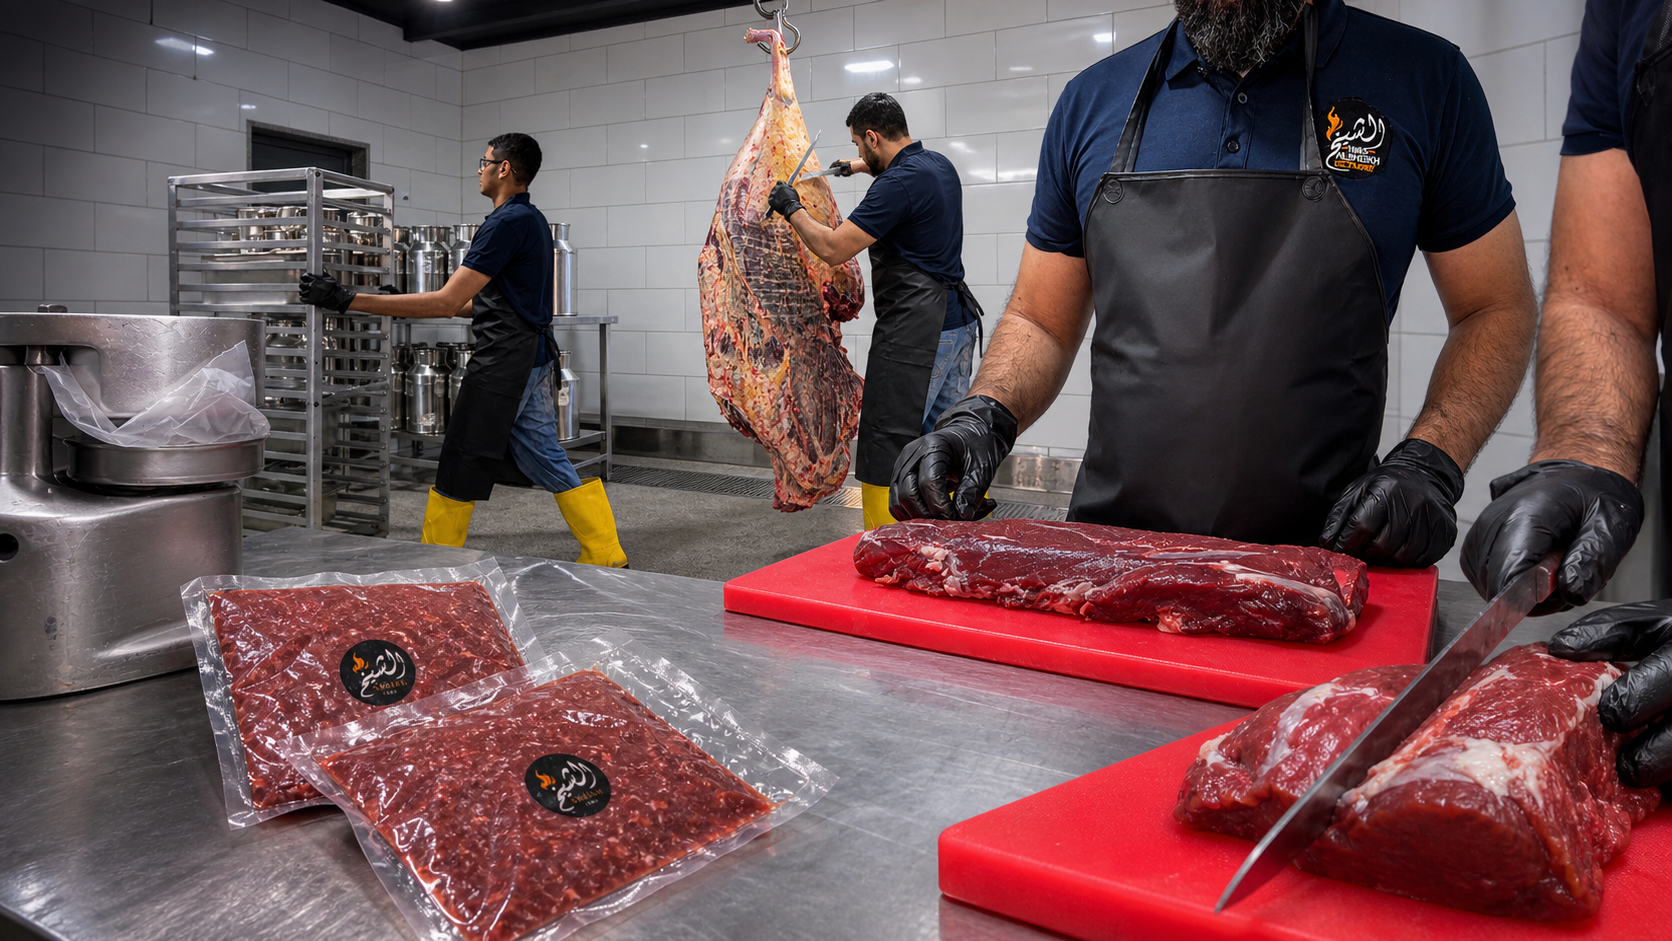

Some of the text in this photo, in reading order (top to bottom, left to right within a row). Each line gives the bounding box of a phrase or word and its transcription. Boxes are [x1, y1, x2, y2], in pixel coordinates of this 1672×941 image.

[1325, 113, 1386, 172] الشيخ
[360, 648, 406, 698] الشيخ
[551, 760, 597, 812] الشيخ
